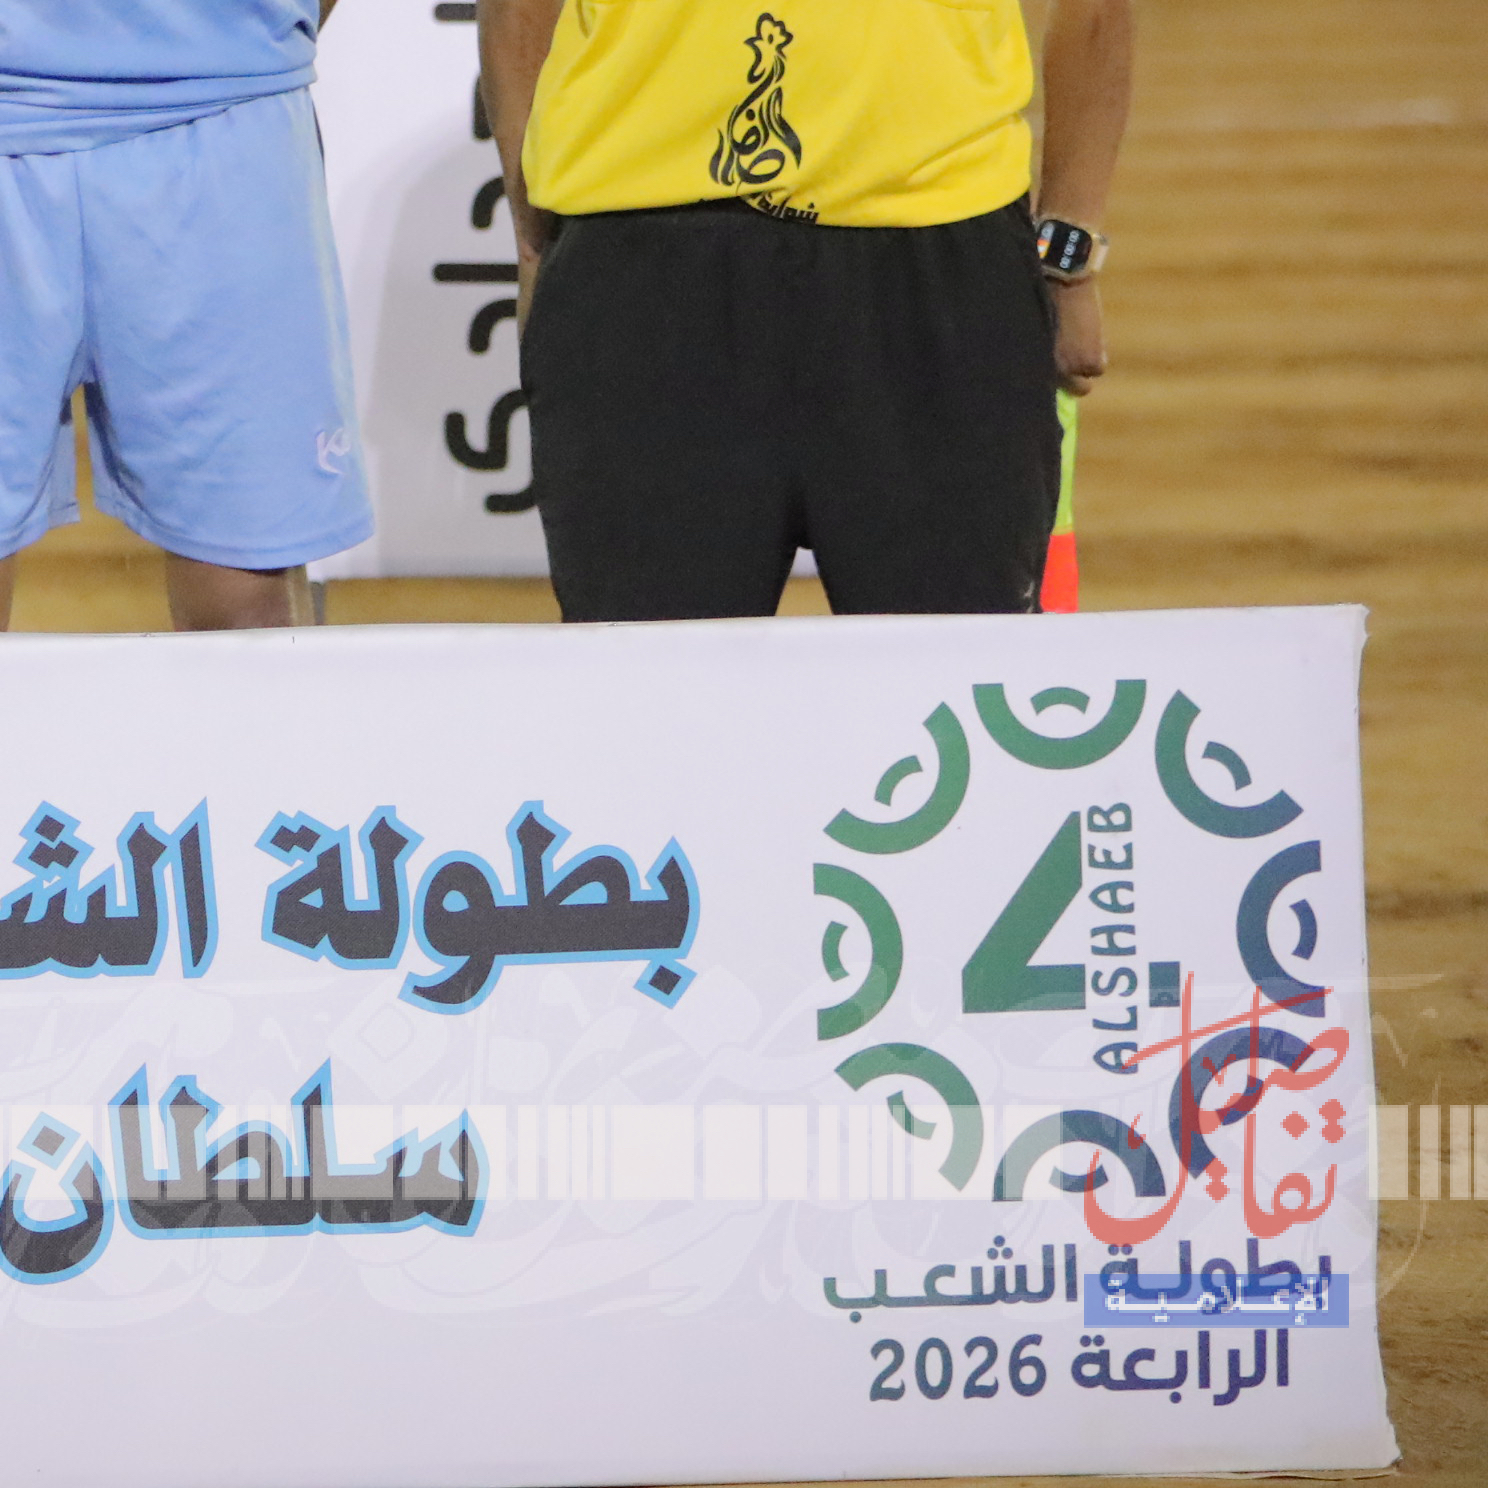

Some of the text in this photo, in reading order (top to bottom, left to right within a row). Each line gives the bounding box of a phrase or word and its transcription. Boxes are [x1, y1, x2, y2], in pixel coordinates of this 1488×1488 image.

[254, 799, 701, 1015] بطولة
[1086, 801, 1140, 1075] ALSHAEB
[823, 1235, 1078, 1325] الشعب
[869, 1326, 1291, 1407] الرابعة 2026
